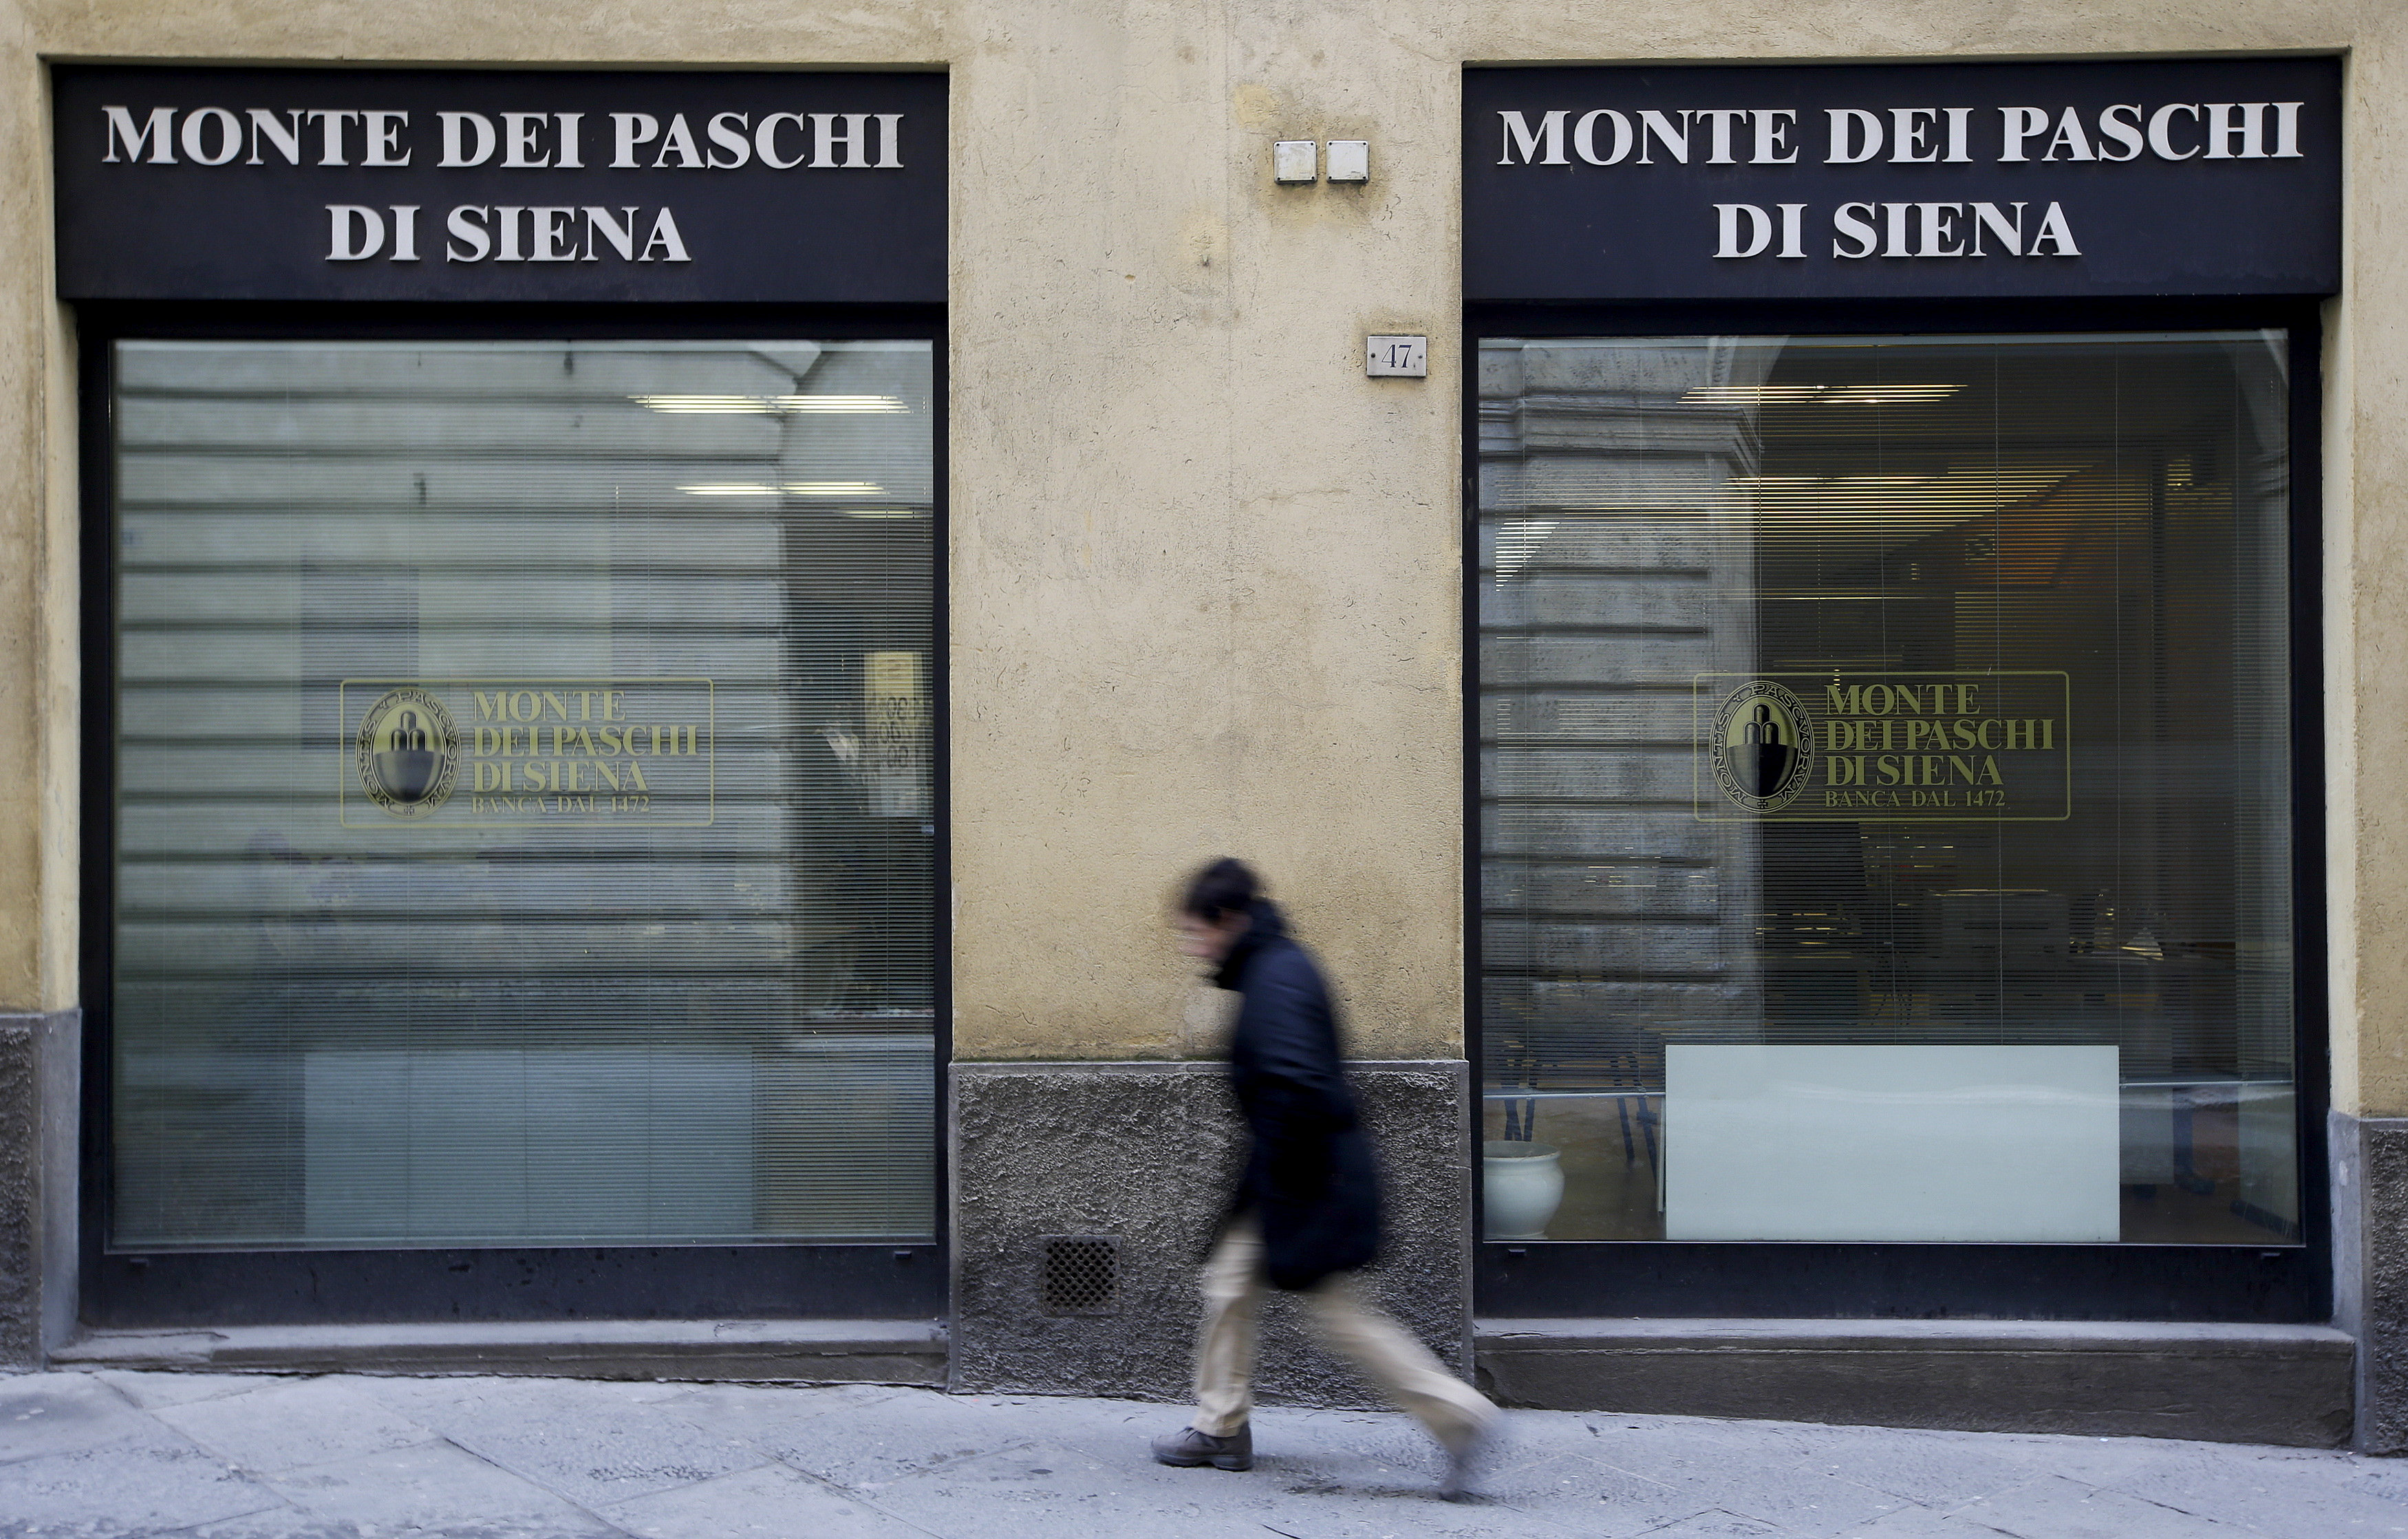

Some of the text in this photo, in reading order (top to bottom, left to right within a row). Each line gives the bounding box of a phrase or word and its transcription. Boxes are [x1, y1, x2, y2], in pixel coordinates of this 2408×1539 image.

[102, 107, 904, 169] MONTE DEI PASCHI
[1496, 102, 2305, 166] MONTE DEI PASCHI
[325, 205, 691, 262] DI SIENA
[1712, 202, 2082, 259] DI SIENA
[1381, 344, 1412, 368] 47
[472, 690, 627, 722] MONTE
[1823, 684, 1981, 716] MONTE
[472, 725, 700, 757] DEI PASCHI
[1824, 719, 2056, 751] DEI PASCHI
[472, 760, 649, 793] DI SIENA
[1824, 755, 2004, 786] DI SIENA
[472, 795, 650, 814] BANCA DAL 1472
[1825, 790, 2006, 808] BANCA DAL 1472
